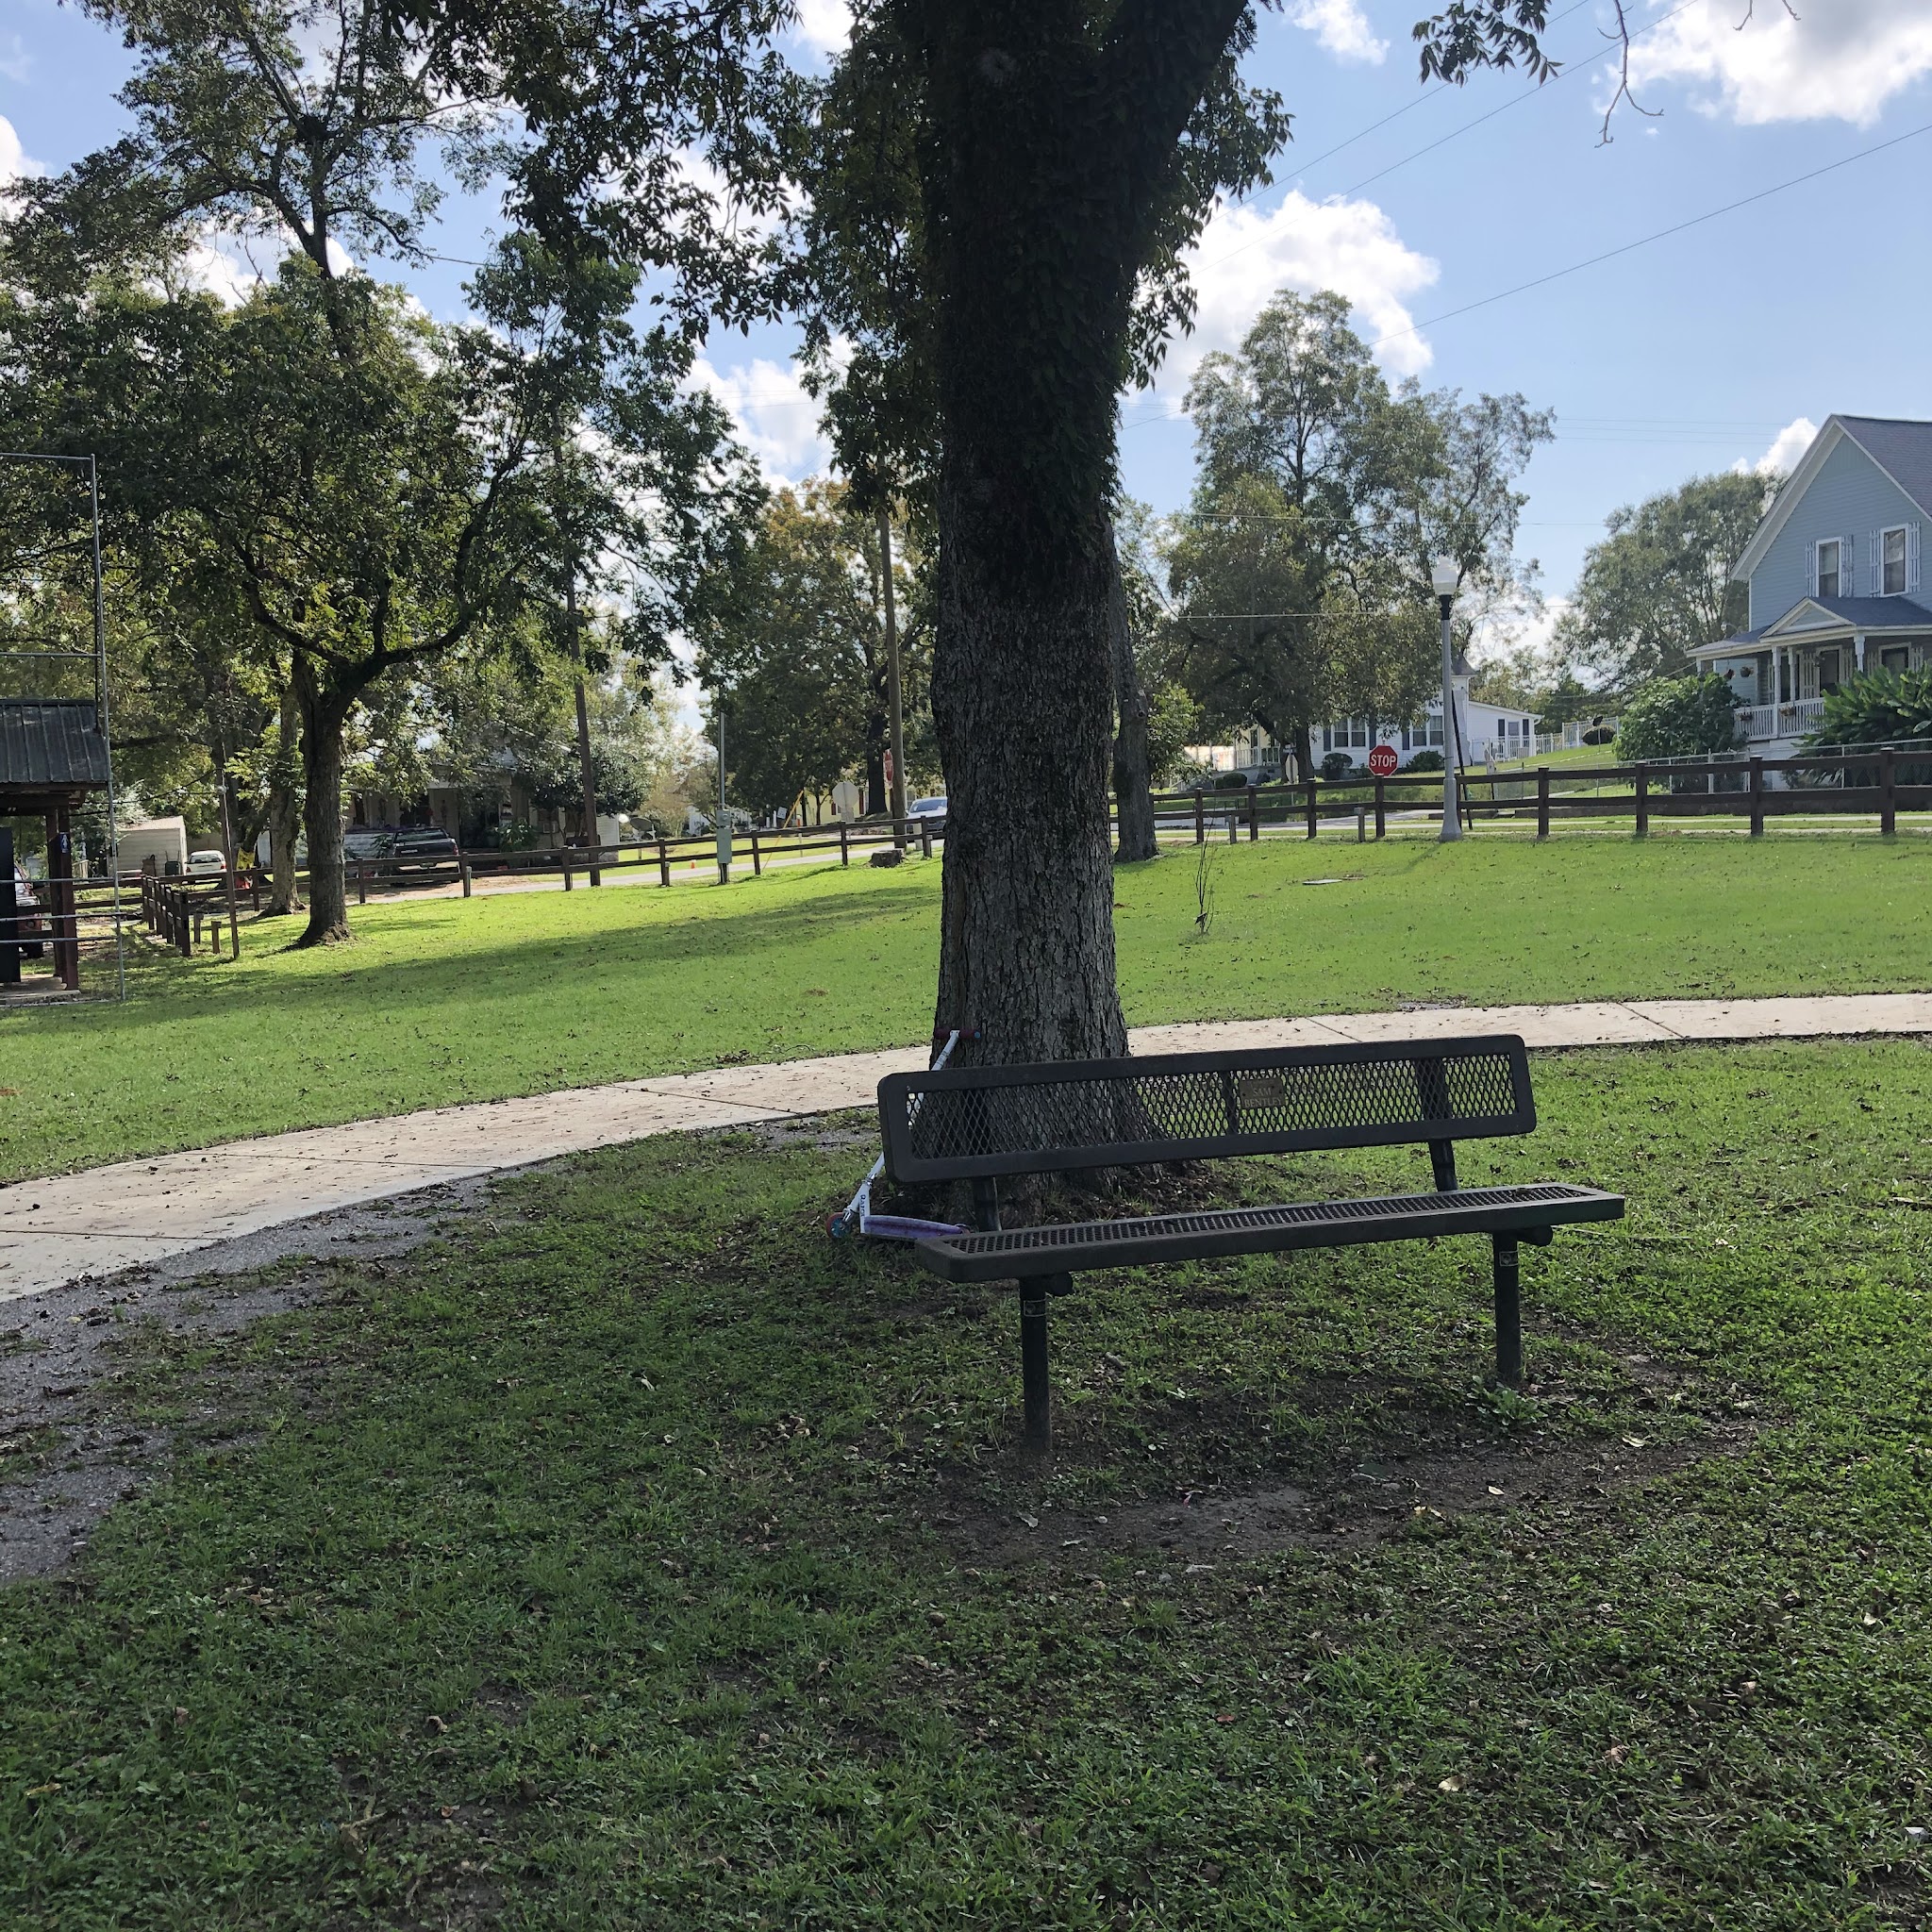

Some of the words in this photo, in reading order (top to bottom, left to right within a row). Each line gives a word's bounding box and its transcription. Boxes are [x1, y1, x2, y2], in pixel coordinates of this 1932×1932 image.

[1371, 755, 1396, 767] STOP
[1253, 1087, 1272, 1096] SAM
[1244, 1095, 1282, 1108] BENTLEY
